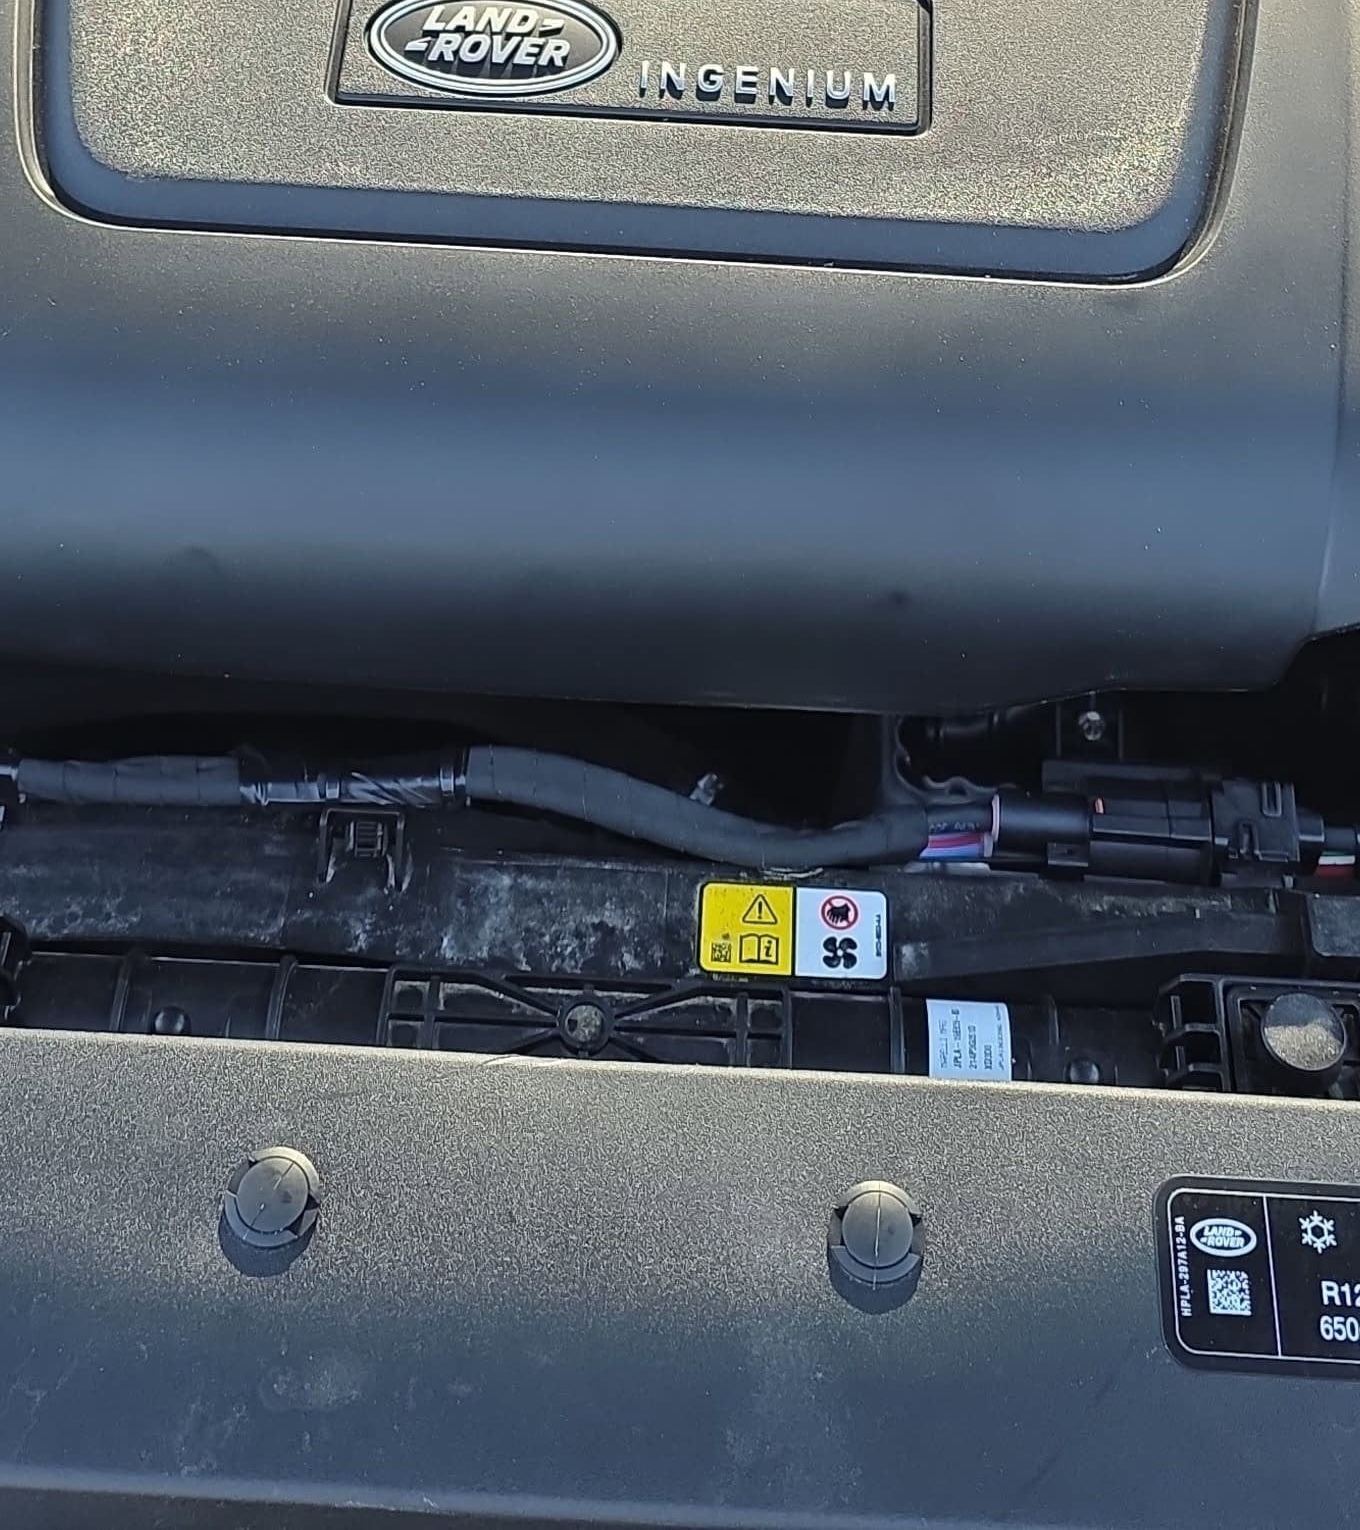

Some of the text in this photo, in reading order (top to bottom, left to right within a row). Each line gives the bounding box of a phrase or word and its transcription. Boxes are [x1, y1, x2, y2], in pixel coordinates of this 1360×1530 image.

[422, 5, 539, 34] LAND
[427, 33, 571, 67] ROVER
[639, 59, 897, 108] INGENIUM
[1203, 1225, 1236, 1237] LAND
[1206, 1235, 1245, 1249] ROVER
